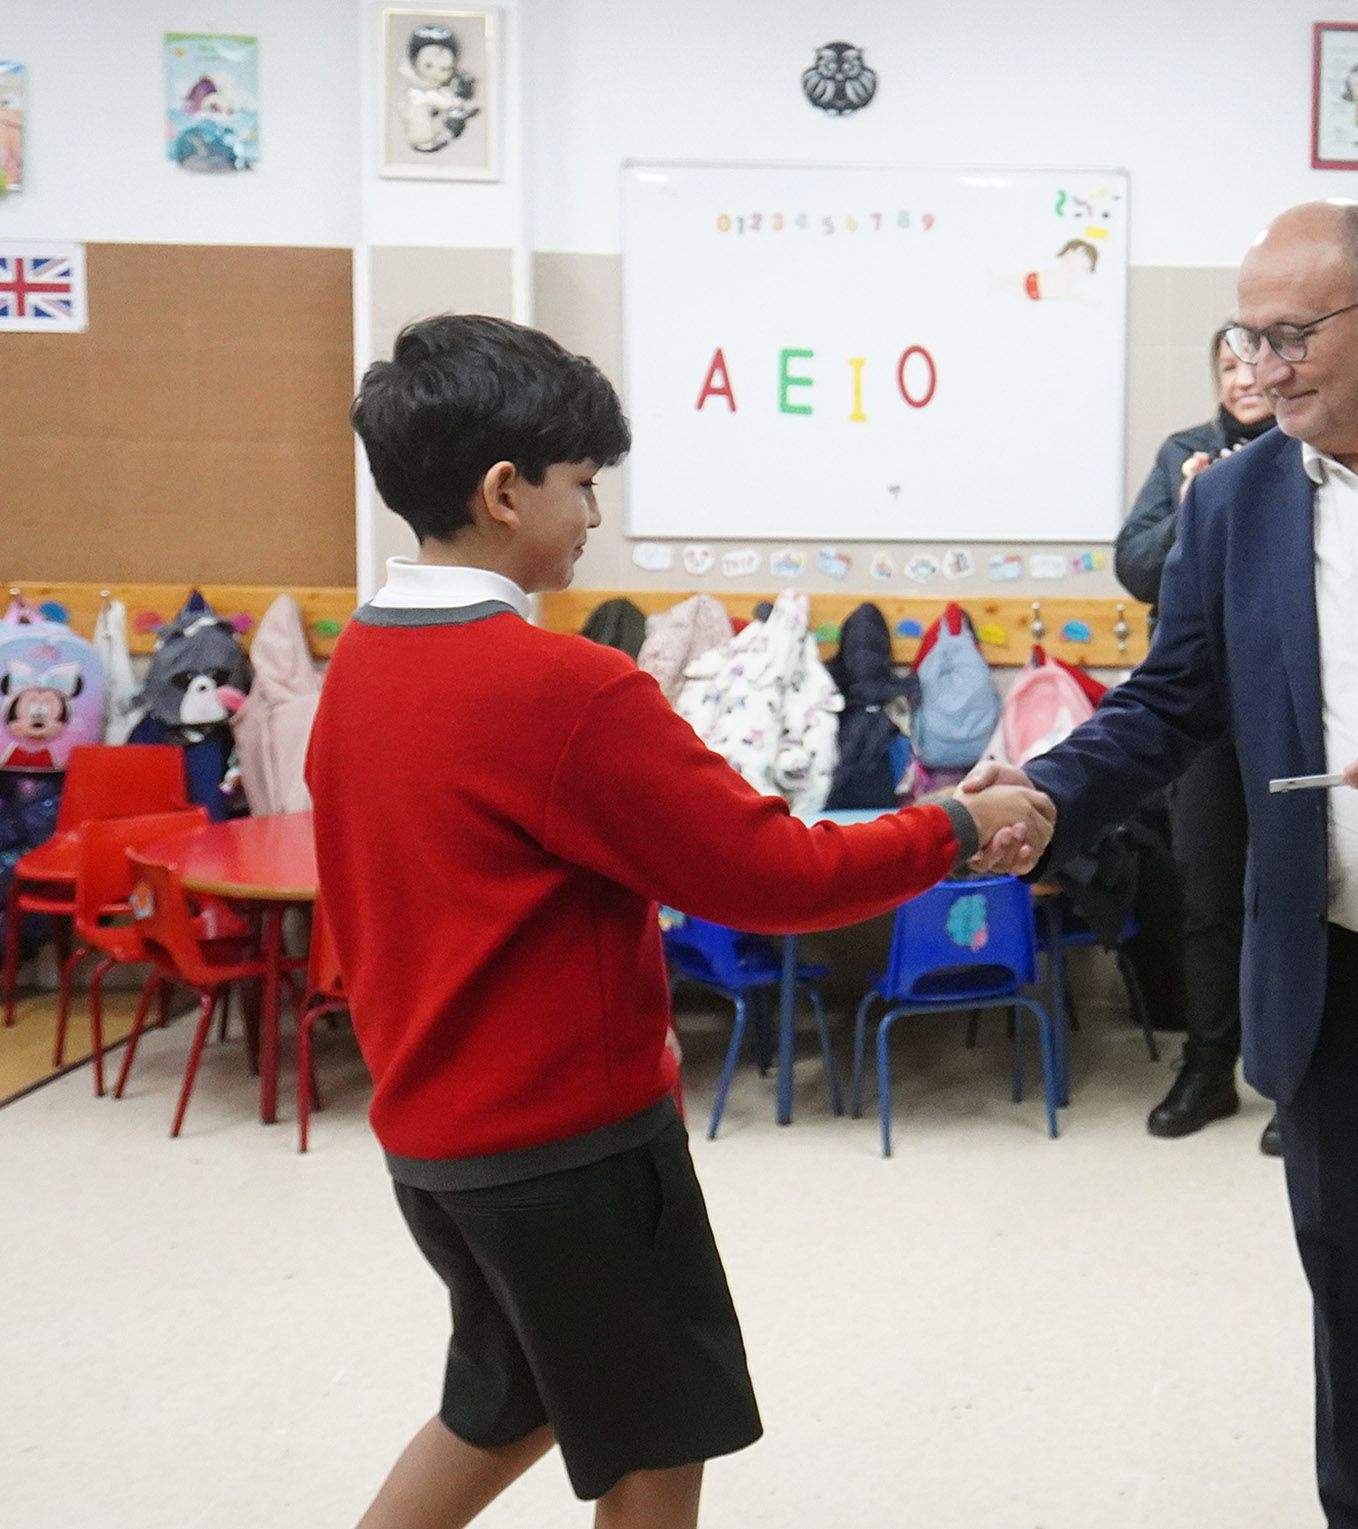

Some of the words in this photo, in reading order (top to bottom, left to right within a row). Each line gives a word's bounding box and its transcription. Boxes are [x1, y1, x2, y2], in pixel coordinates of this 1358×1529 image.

[696, 347, 736, 412] A
[779, 348, 815, 414] E
[849, 357, 867, 423] I
[896, 345, 937, 409] O
